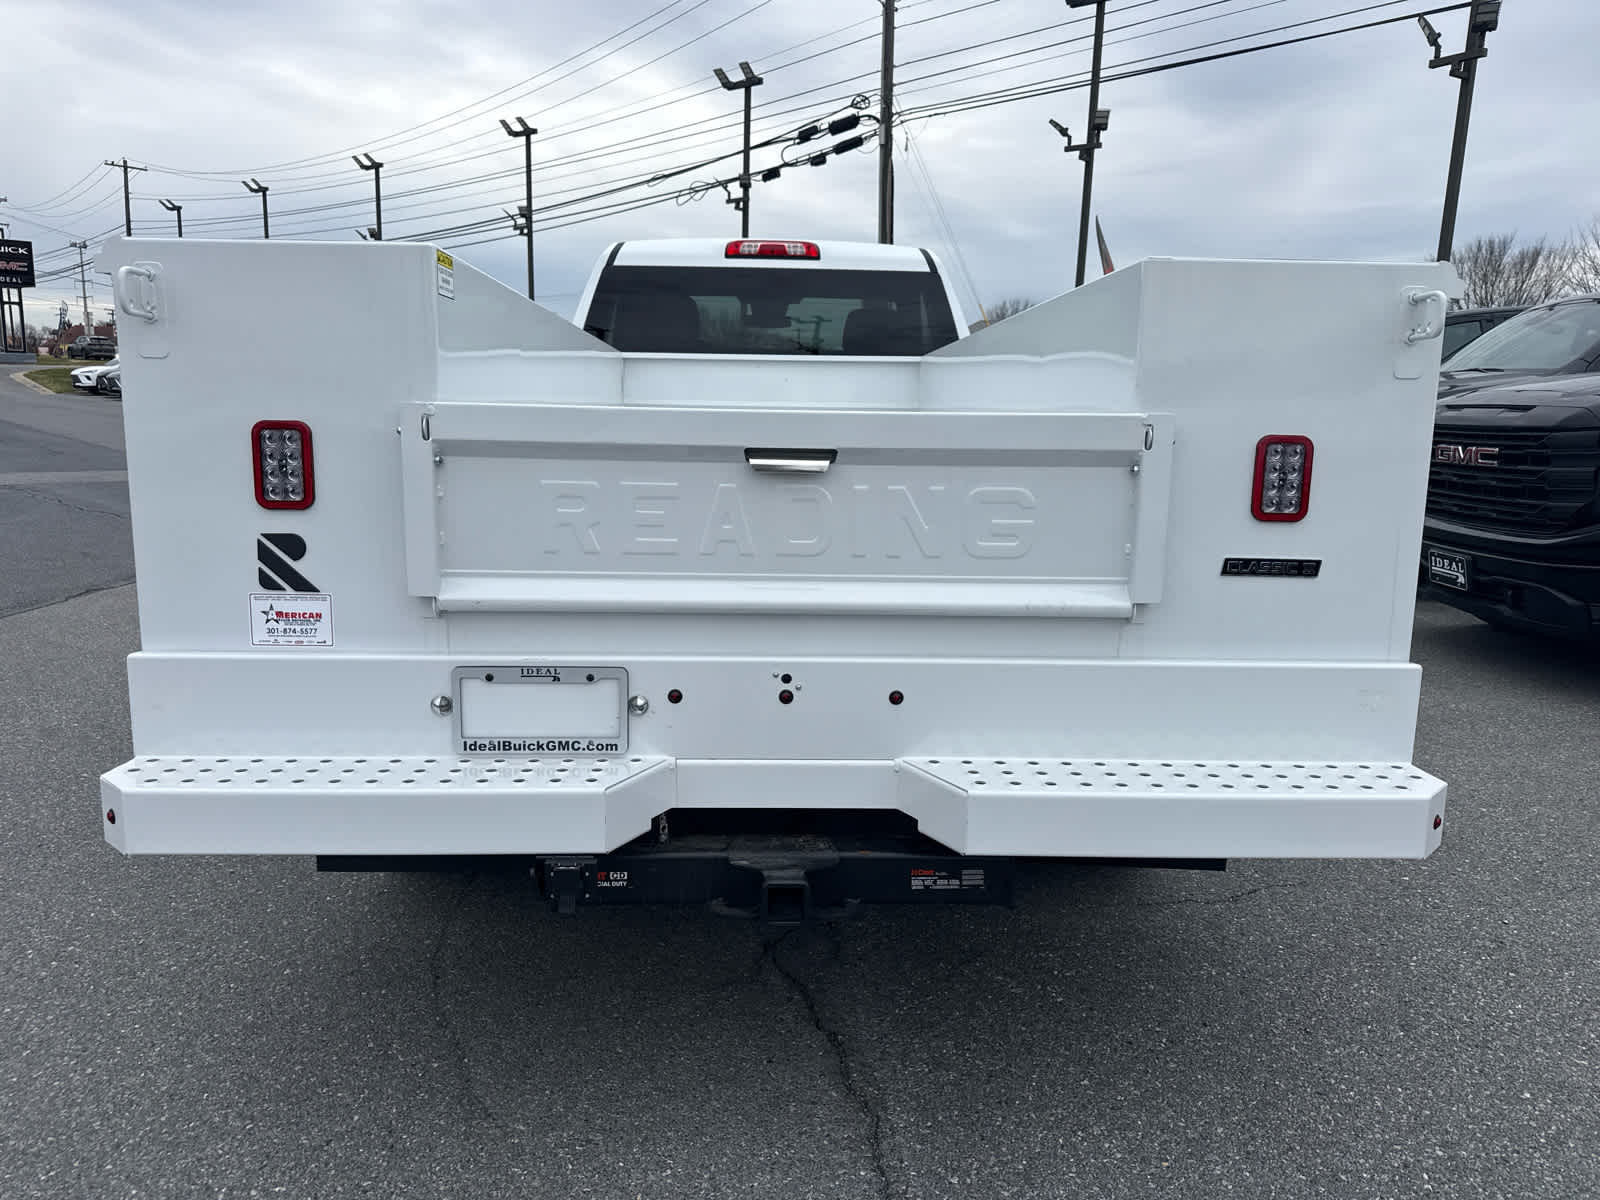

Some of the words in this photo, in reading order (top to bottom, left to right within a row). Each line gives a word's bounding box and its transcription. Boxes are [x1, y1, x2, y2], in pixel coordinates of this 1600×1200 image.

[1434, 444, 1499, 466] GMC
[539, 479, 1036, 560] READING
[1225, 560, 1299, 575] CLASSIC
[1431, 556, 1465, 573] IDEAL
[266, 627, 318, 635] 301-874-5577
[463, 740, 619, 752] IdealBuickGMC.com
